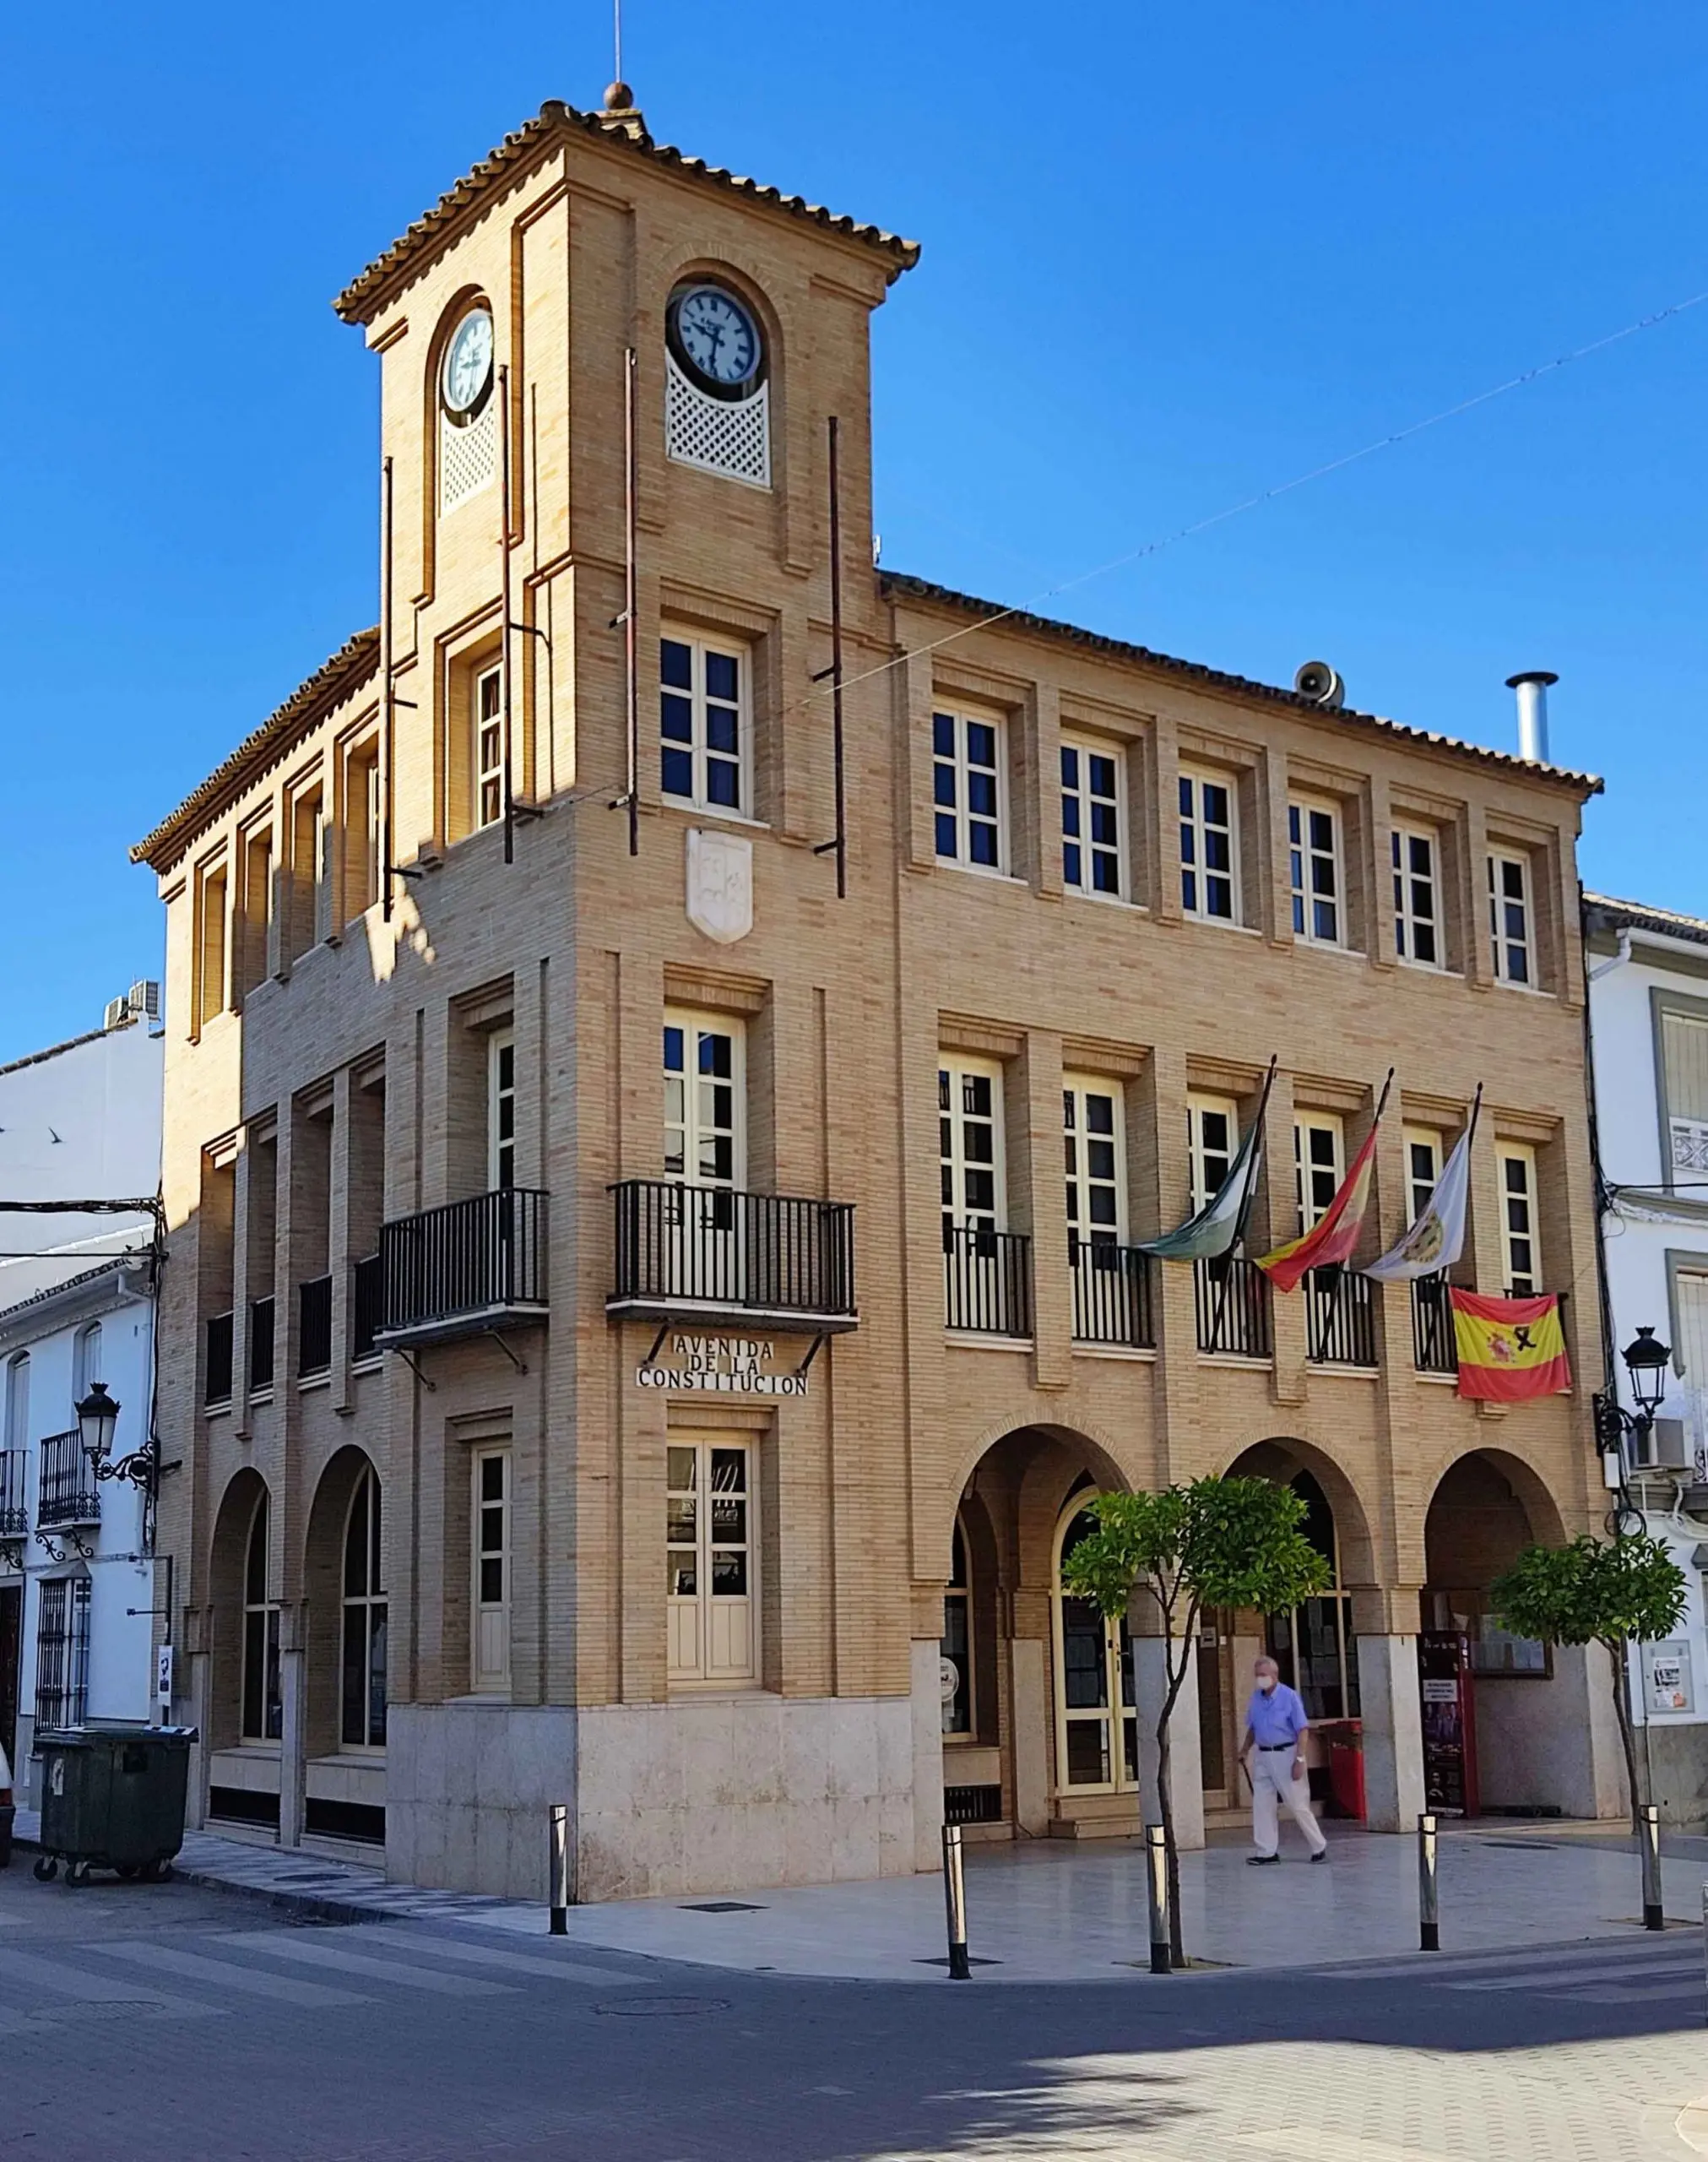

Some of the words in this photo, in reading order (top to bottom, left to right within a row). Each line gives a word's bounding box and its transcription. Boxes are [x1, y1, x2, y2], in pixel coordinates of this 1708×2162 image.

[675, 1337, 773, 1359] AVENIDA
[691, 1355, 716, 1372] DE
[734, 1357, 758, 1375] LA
[639, 1369, 806, 1394] CONSTITUCION
